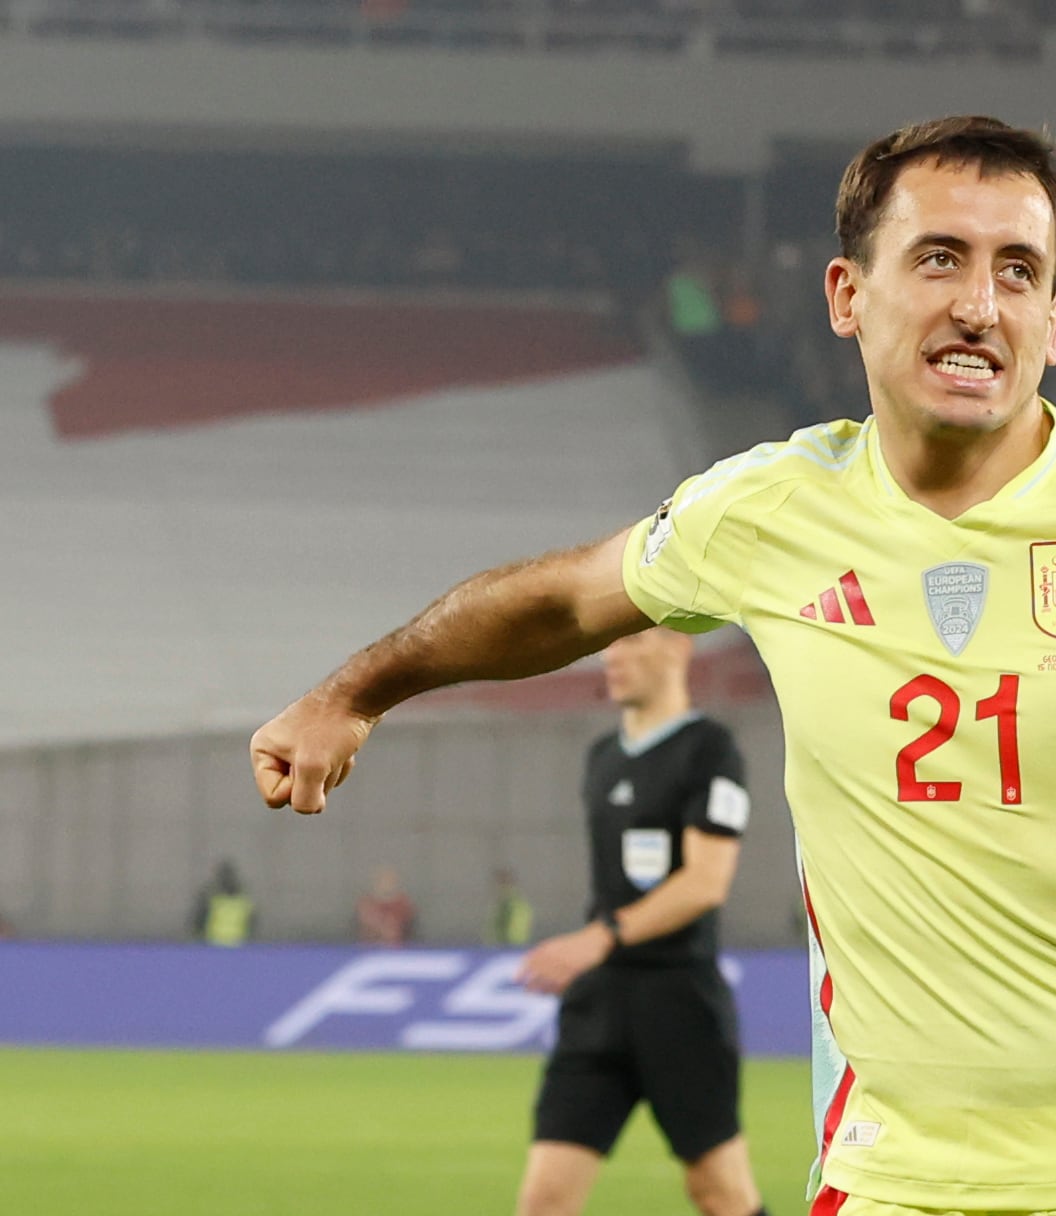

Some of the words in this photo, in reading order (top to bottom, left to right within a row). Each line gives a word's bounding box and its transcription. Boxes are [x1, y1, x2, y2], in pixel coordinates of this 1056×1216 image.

[928, 574, 982, 586] EUROPEAN
[928, 584, 982, 596] CHAMPIONS
[942, 625, 969, 635] 2024
[889, 673, 1022, 805] 21
